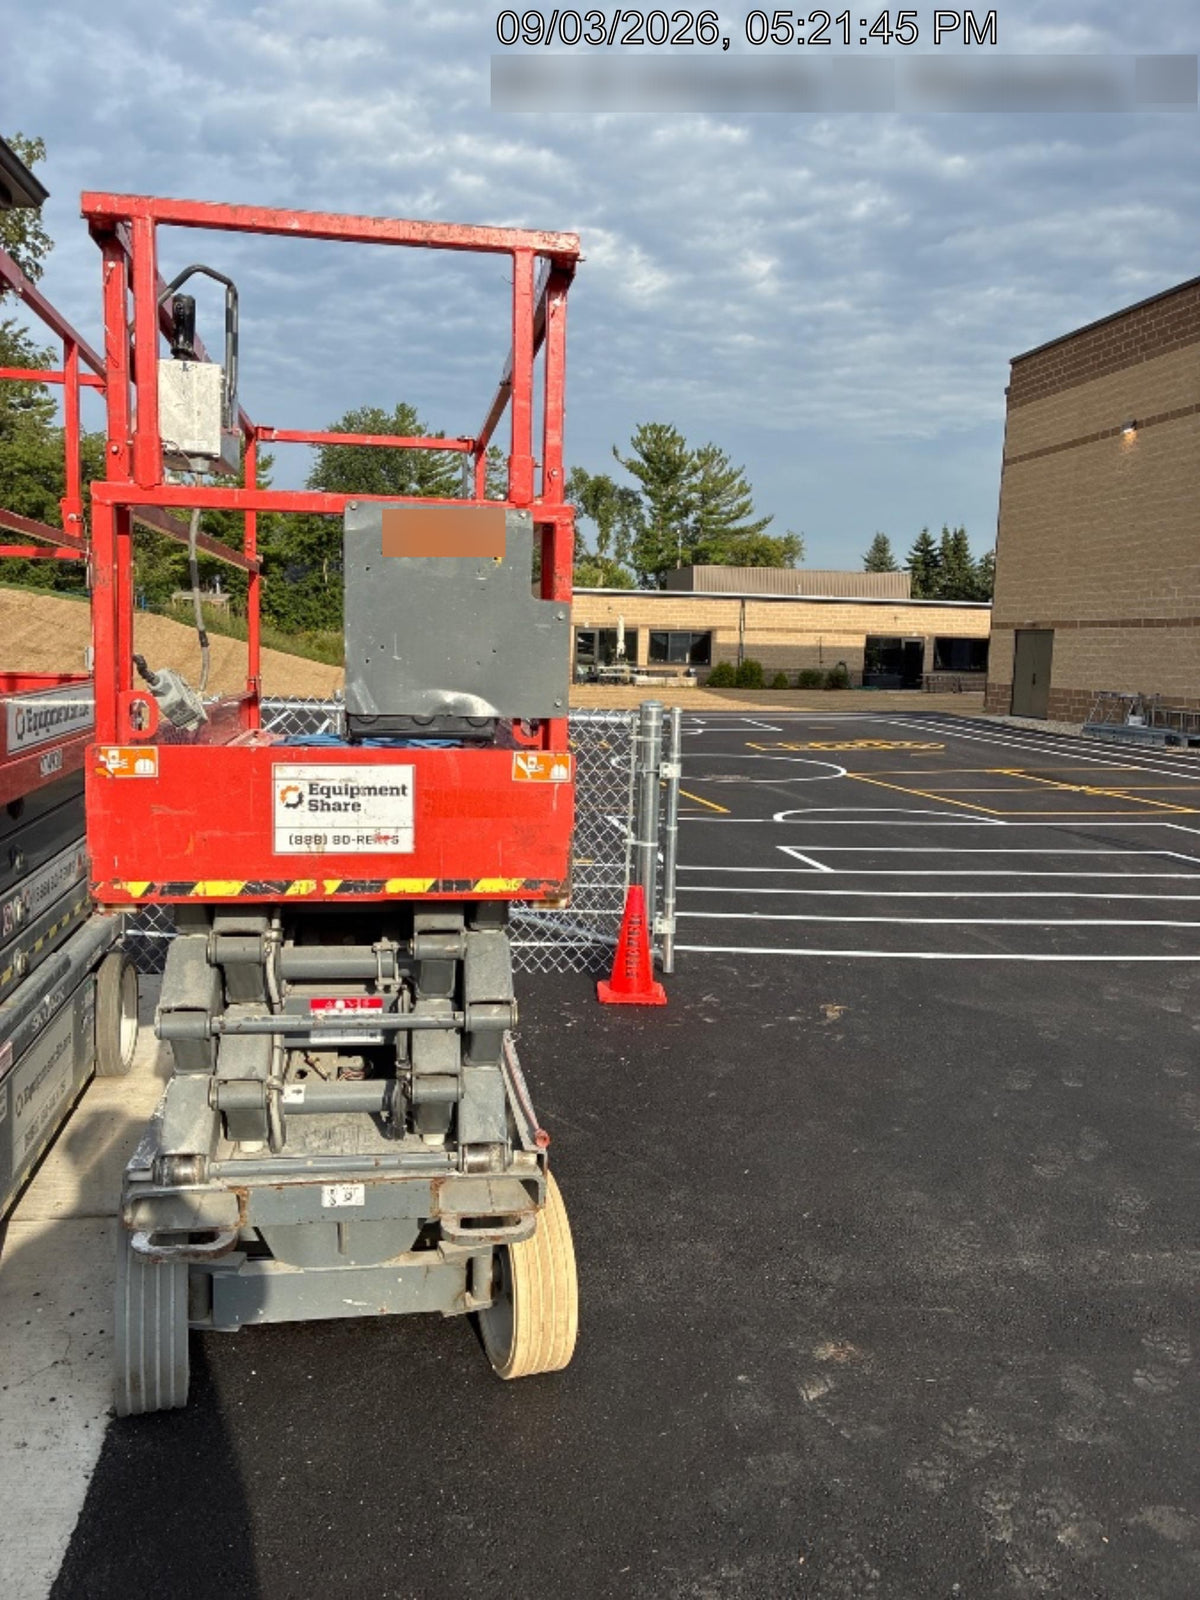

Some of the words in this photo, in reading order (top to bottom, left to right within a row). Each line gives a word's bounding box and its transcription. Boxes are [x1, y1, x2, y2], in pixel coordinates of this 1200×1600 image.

[308, 783, 408, 798] Equipment
[308, 799, 361, 812] Share
[332, 835, 399, 846] 80-RES
